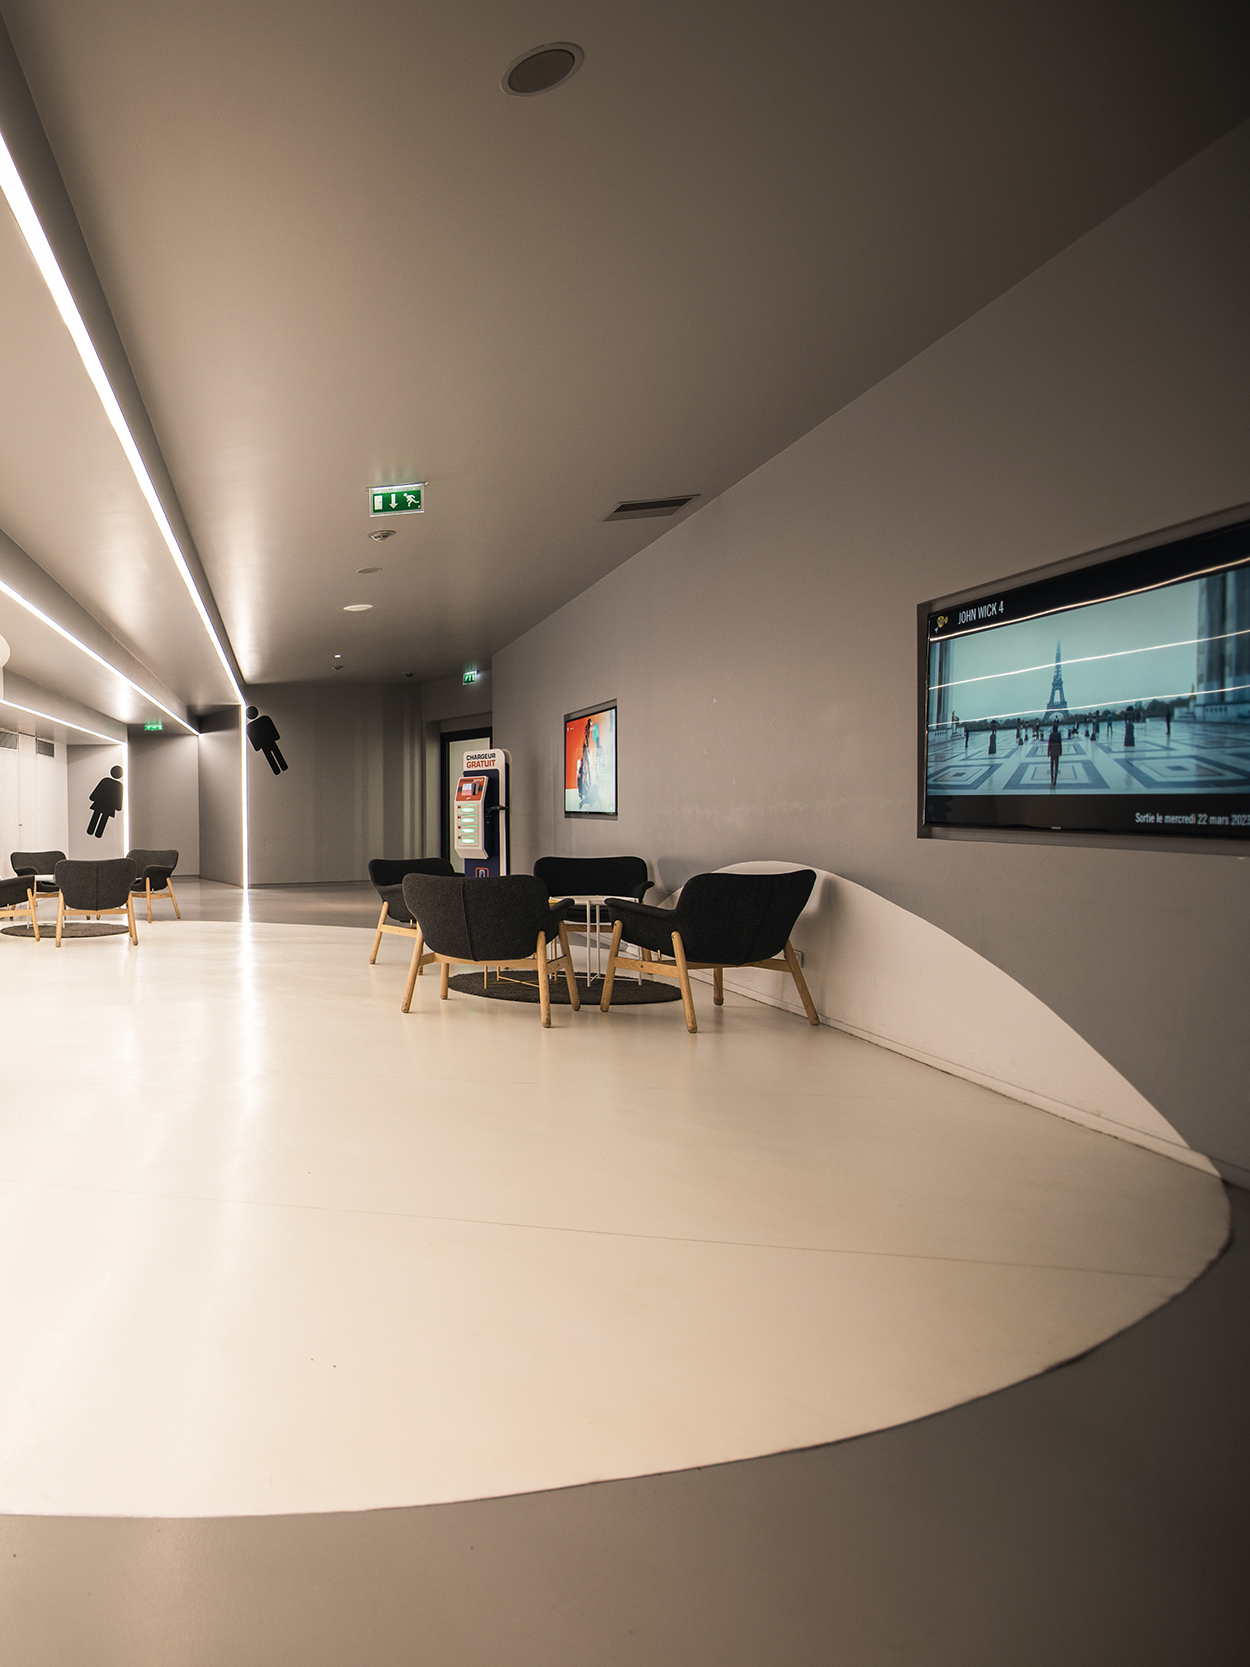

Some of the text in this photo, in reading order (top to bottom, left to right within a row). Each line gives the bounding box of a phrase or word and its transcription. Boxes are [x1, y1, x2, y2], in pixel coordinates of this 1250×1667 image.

[958, 600, 1004, 625] JOHN WICK 4
[466, 753, 496, 761] CHARGEUR
[466, 759, 496, 769] GRATUIT
[1135, 812, 1156, 823] Sortie
[1156, 812, 1164, 824] le
[1164, 813, 1197, 824] mercredi
[1197, 813, 1208, 825] 22
[1209, 815, 1230, 825] mars
